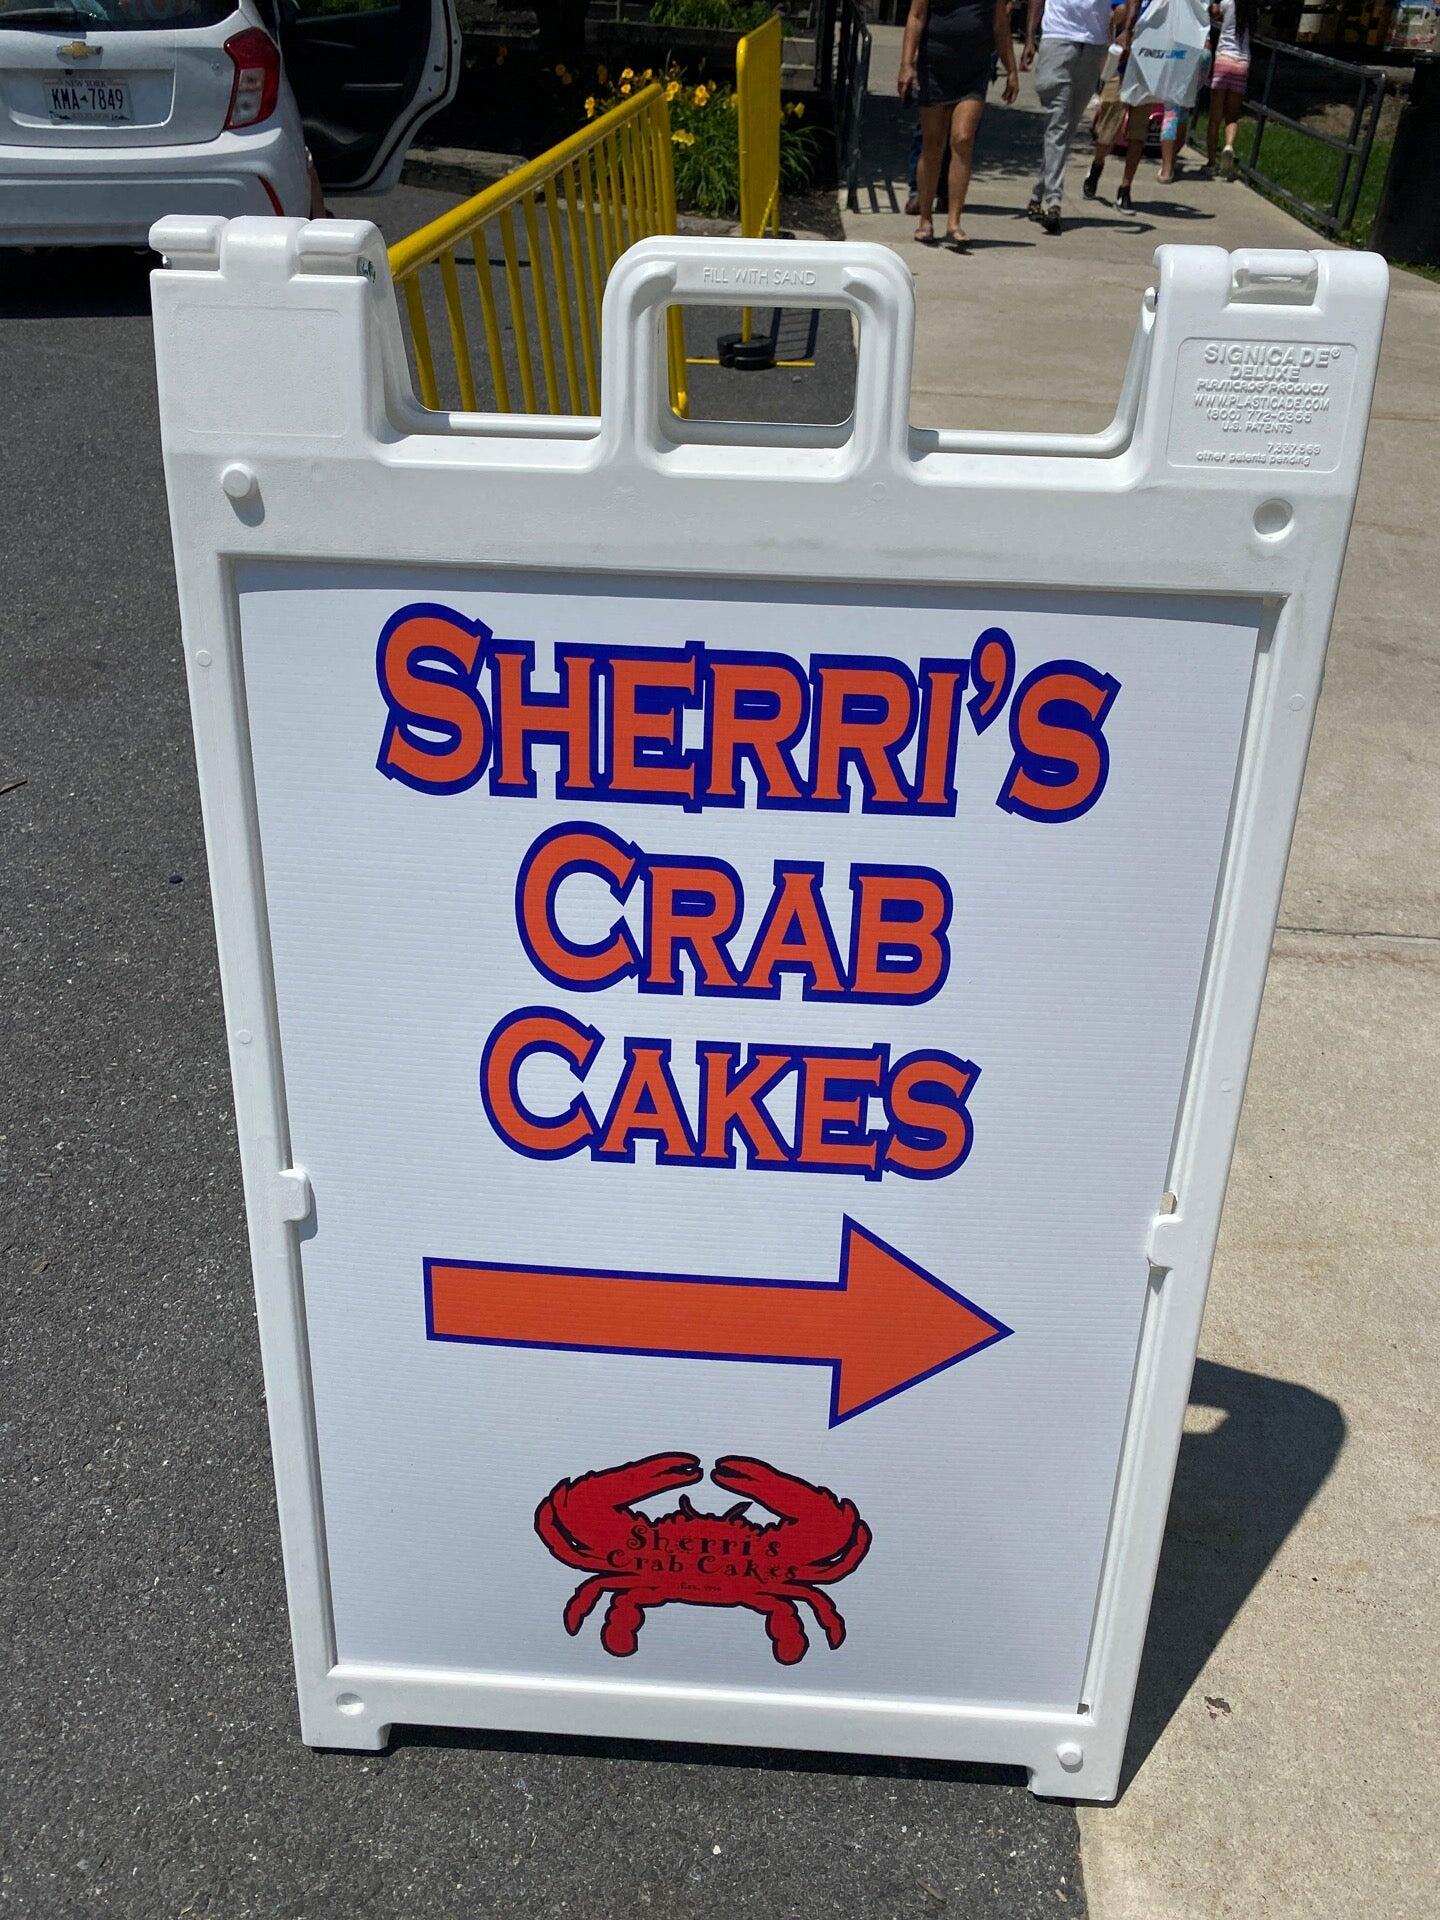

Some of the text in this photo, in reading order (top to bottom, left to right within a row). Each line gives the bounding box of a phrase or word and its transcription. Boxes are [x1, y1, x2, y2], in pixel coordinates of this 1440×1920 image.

[703, 267, 817, 286] FILL WITH SAND
[1230, 364, 1300, 382] DELUXE
[1194, 393, 1330, 412] WWW.PLASTICADE.COM
[1207, 408, 1241, 421] (800)
[1222, 421, 1294, 435] U.S. PATENTS
[375, 602, 1121, 823] SHERRI'S
[515, 821, 953, 1006] CRAB
[480, 1006, 982, 1181] CAKES
[627, 1525, 781, 1557] Sherri's
[606, 1549, 799, 1584] Crab Cakes
